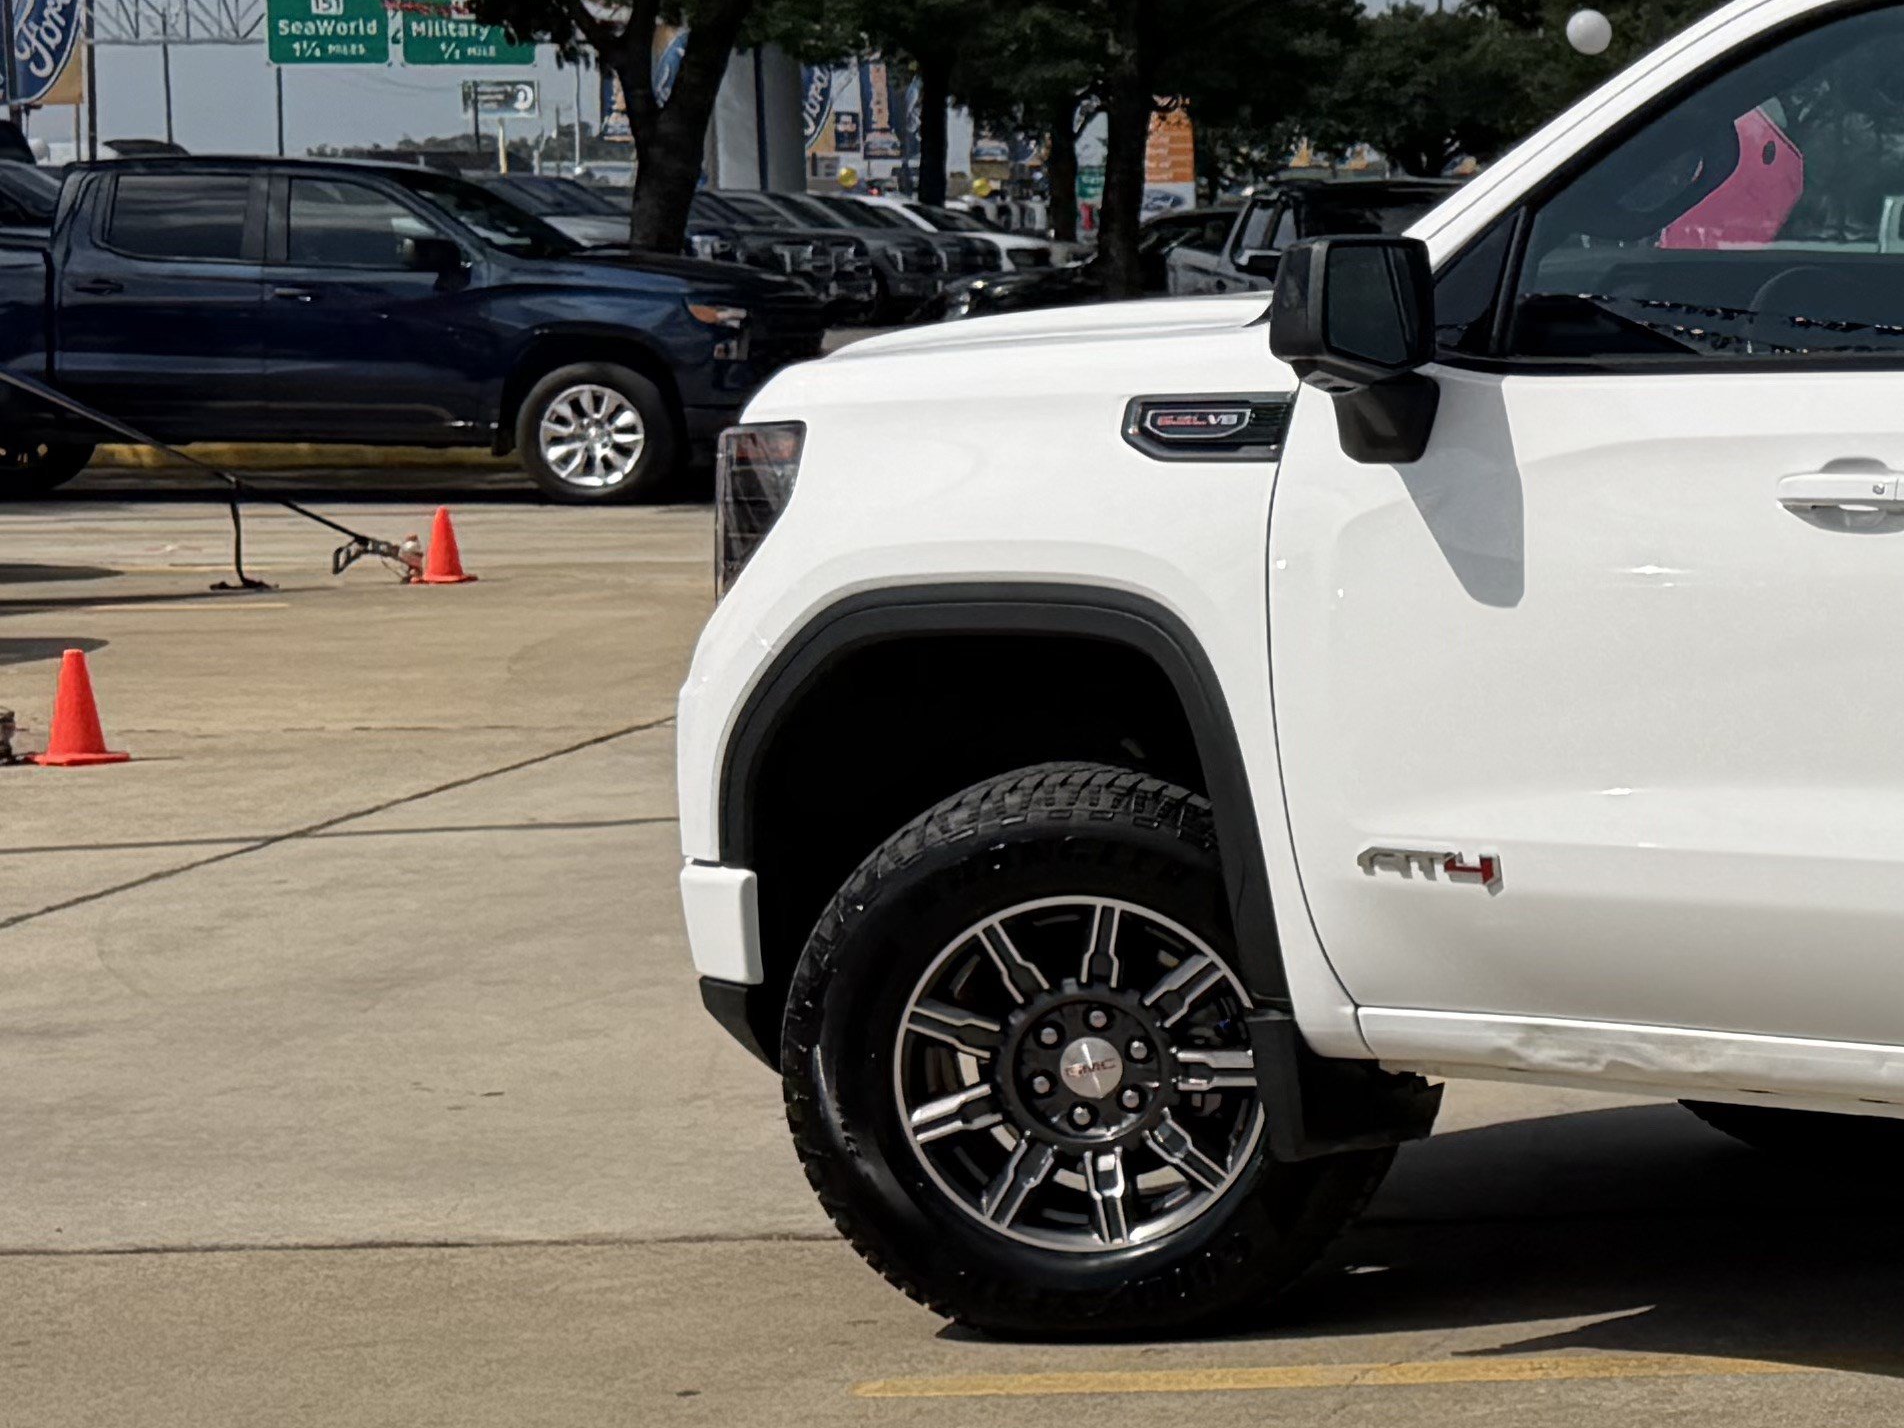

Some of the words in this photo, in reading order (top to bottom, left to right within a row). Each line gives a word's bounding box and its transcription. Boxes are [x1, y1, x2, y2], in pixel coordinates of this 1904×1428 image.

[278, 18, 378, 37] SeaWorld
[411, 20, 491, 41] Military
[327, 43, 367, 56] MILES
[466, 44, 496, 58] MILE
[1357, 846, 1504, 897] AT4
